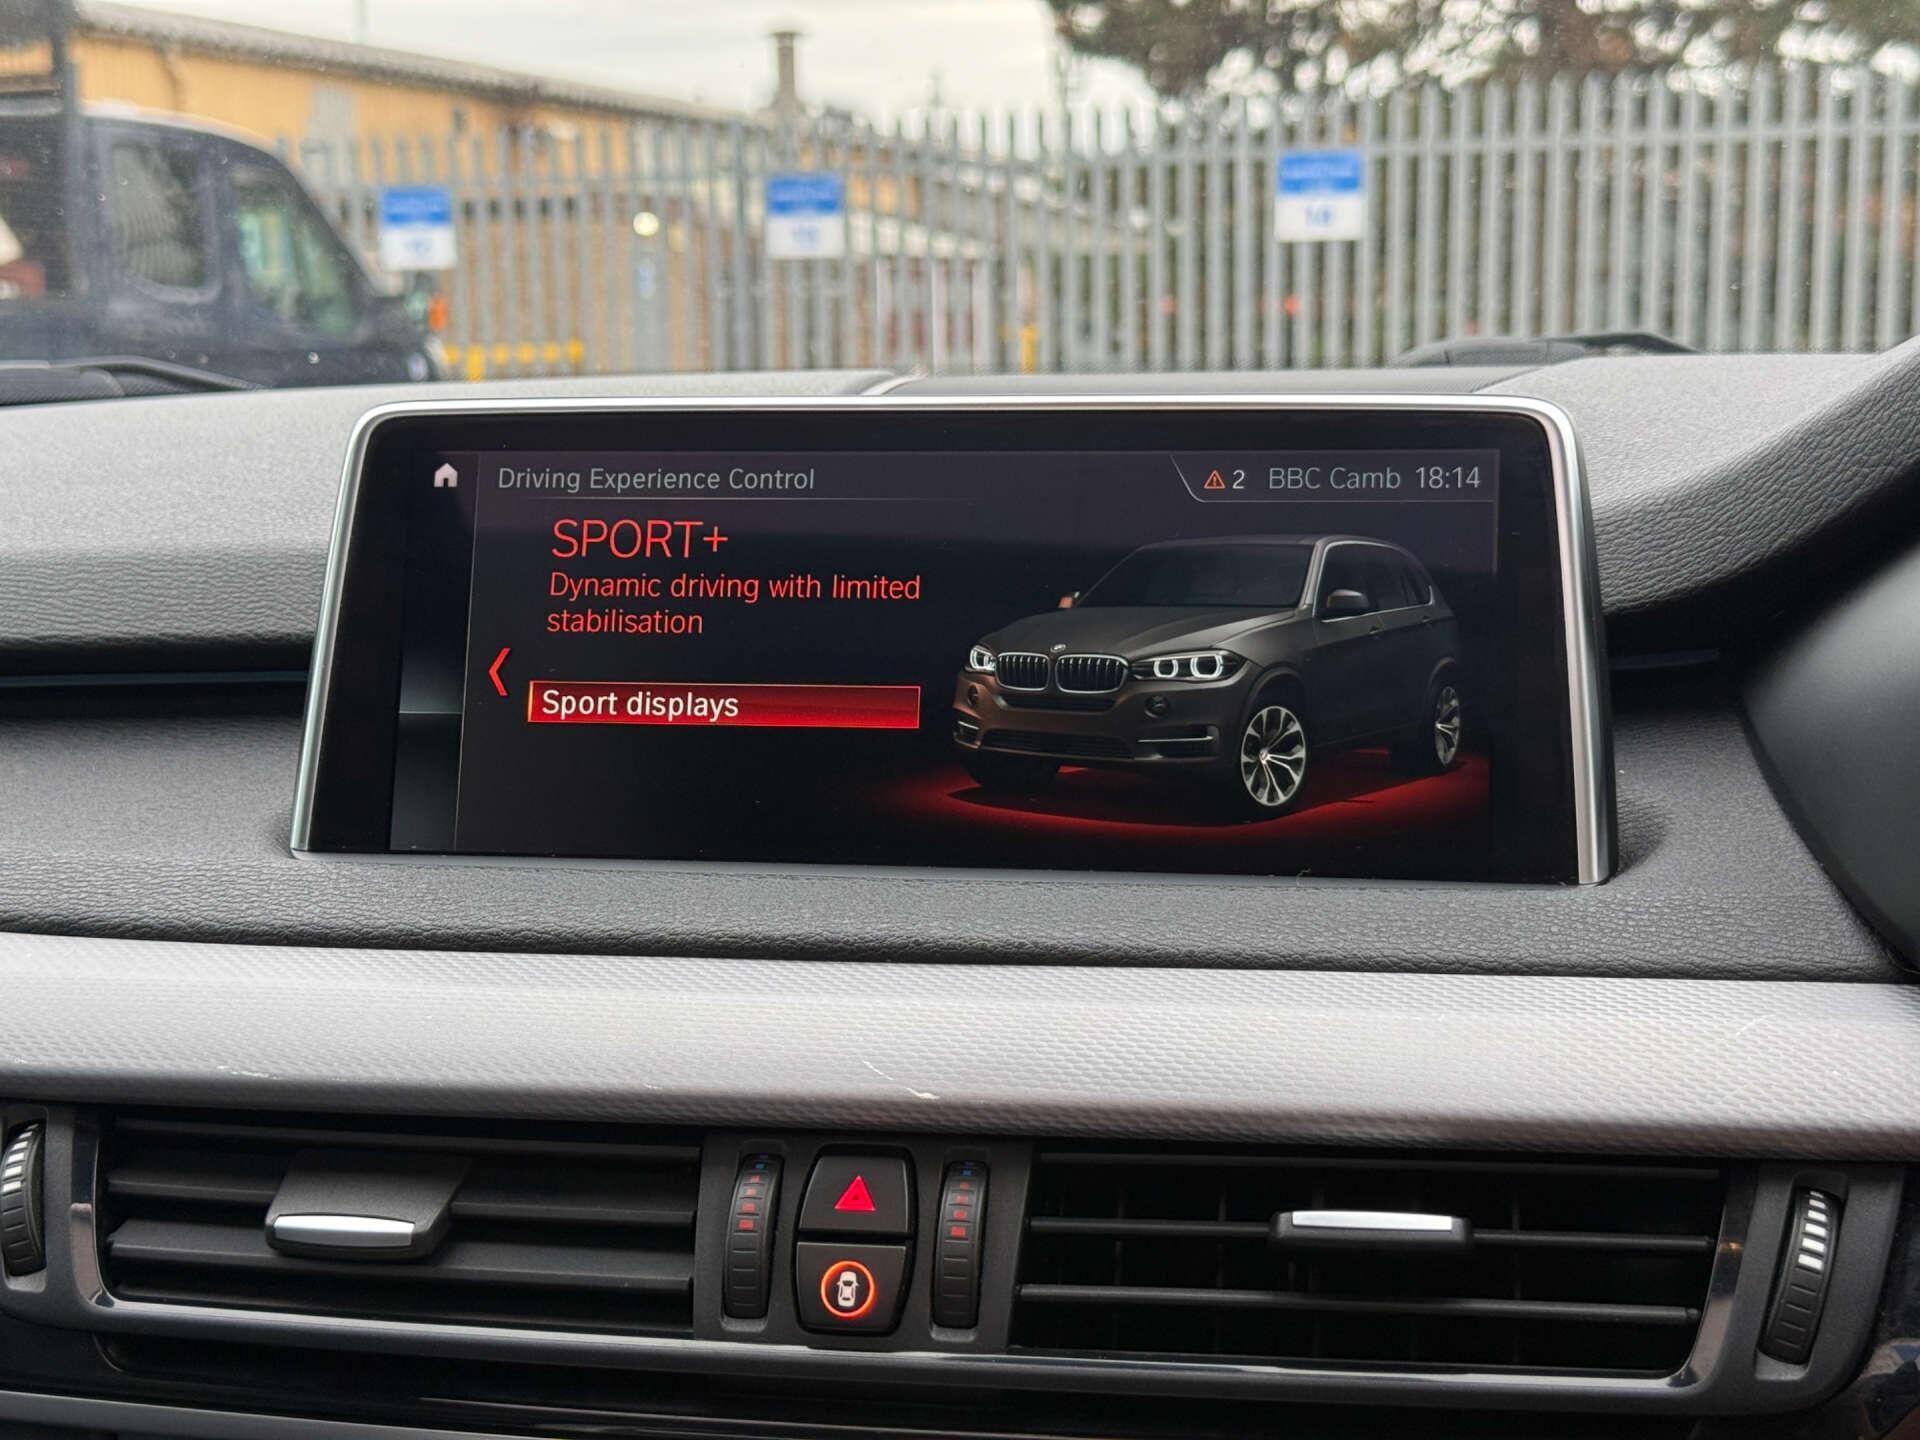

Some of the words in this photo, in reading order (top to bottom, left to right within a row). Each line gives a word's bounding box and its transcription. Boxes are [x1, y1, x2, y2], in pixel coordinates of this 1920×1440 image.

[499, 467, 580, 494] Driving
[590, 468, 721, 494] Experience
[729, 468, 814, 489] Control
[1232, 469, 1245, 489] 2
[1269, 467, 1321, 489] BBC
[1329, 467, 1401, 489] Camb
[1415, 466, 1481, 489] 18:14
[551, 518, 729, 559] SPORT+
[550, 571, 661, 602] Dynamic
[670, 573, 760, 604] driving
[769, 574, 821, 598] with
[832, 574, 921, 600] limited
[547, 608, 703, 634] stabilisation
[542, 689, 618, 721] Sport
[626, 691, 739, 723] displays
